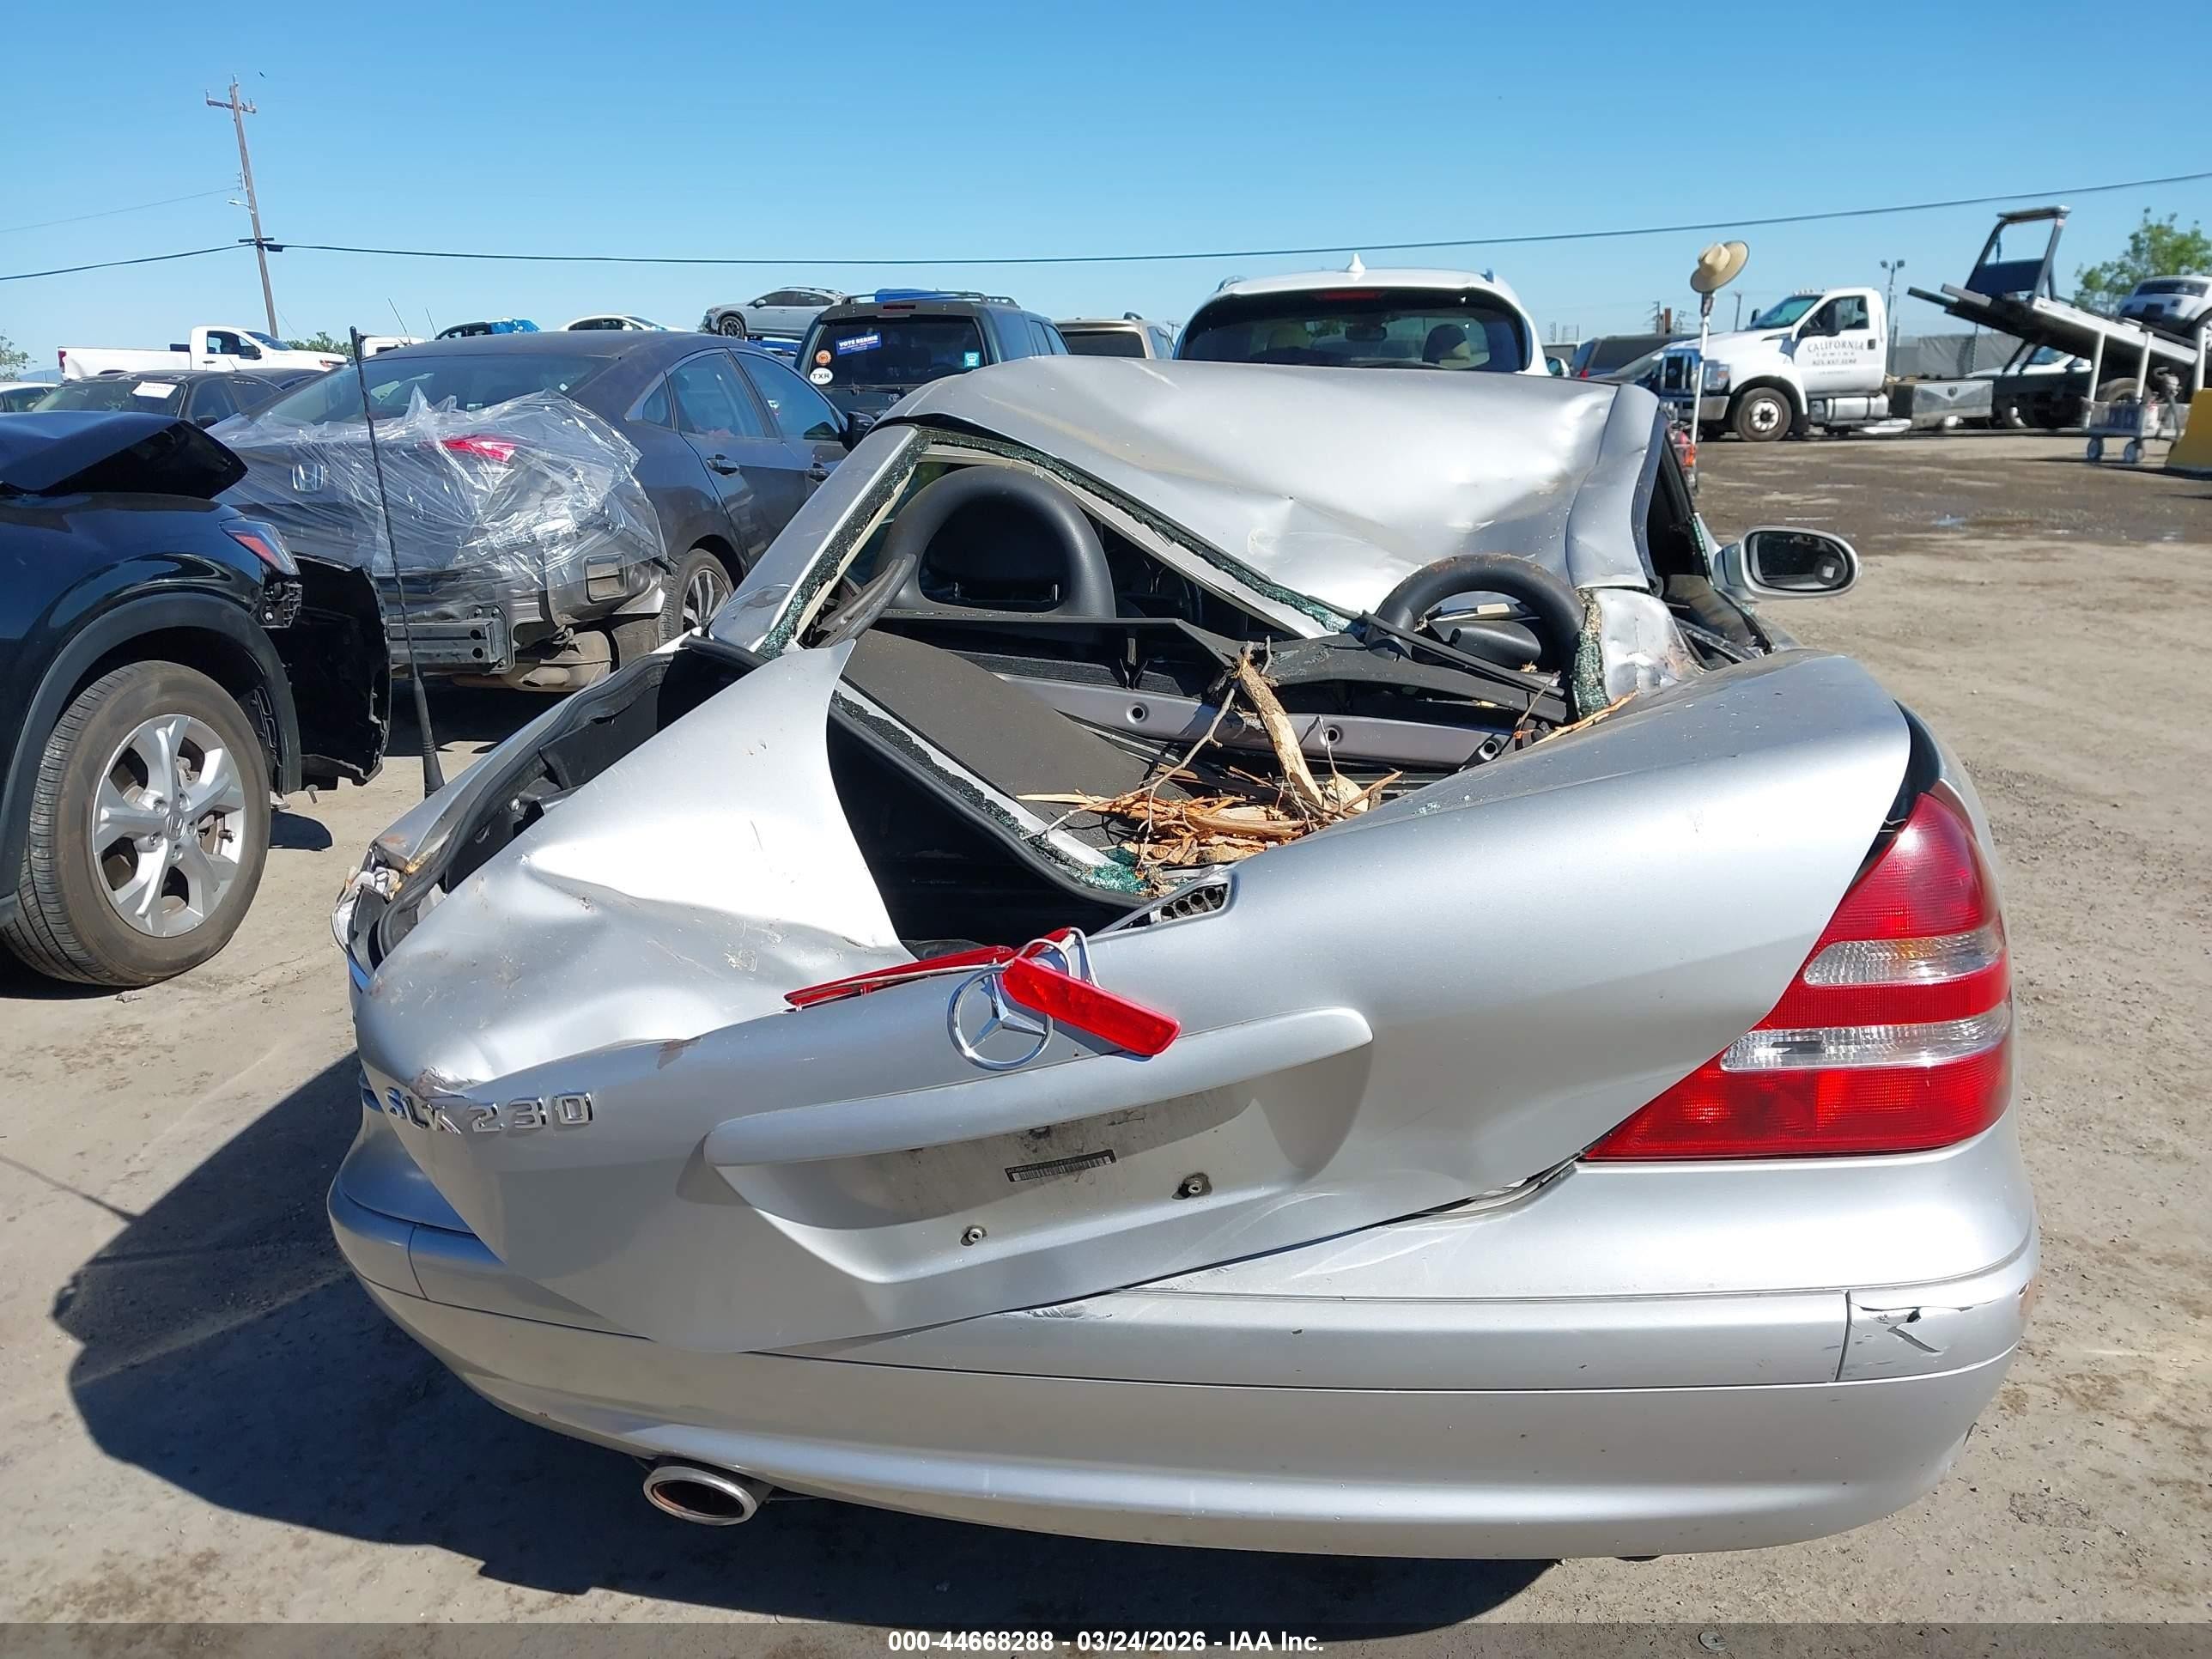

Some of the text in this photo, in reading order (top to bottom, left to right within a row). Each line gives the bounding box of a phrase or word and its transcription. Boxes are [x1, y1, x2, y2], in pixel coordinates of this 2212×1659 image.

[838, 338, 856, 348] VOTE
[855, 335, 878, 345] BERNIE
[1807, 340, 1864, 352] CALIFORNIA
[468, 1091, 596, 1133] 230
